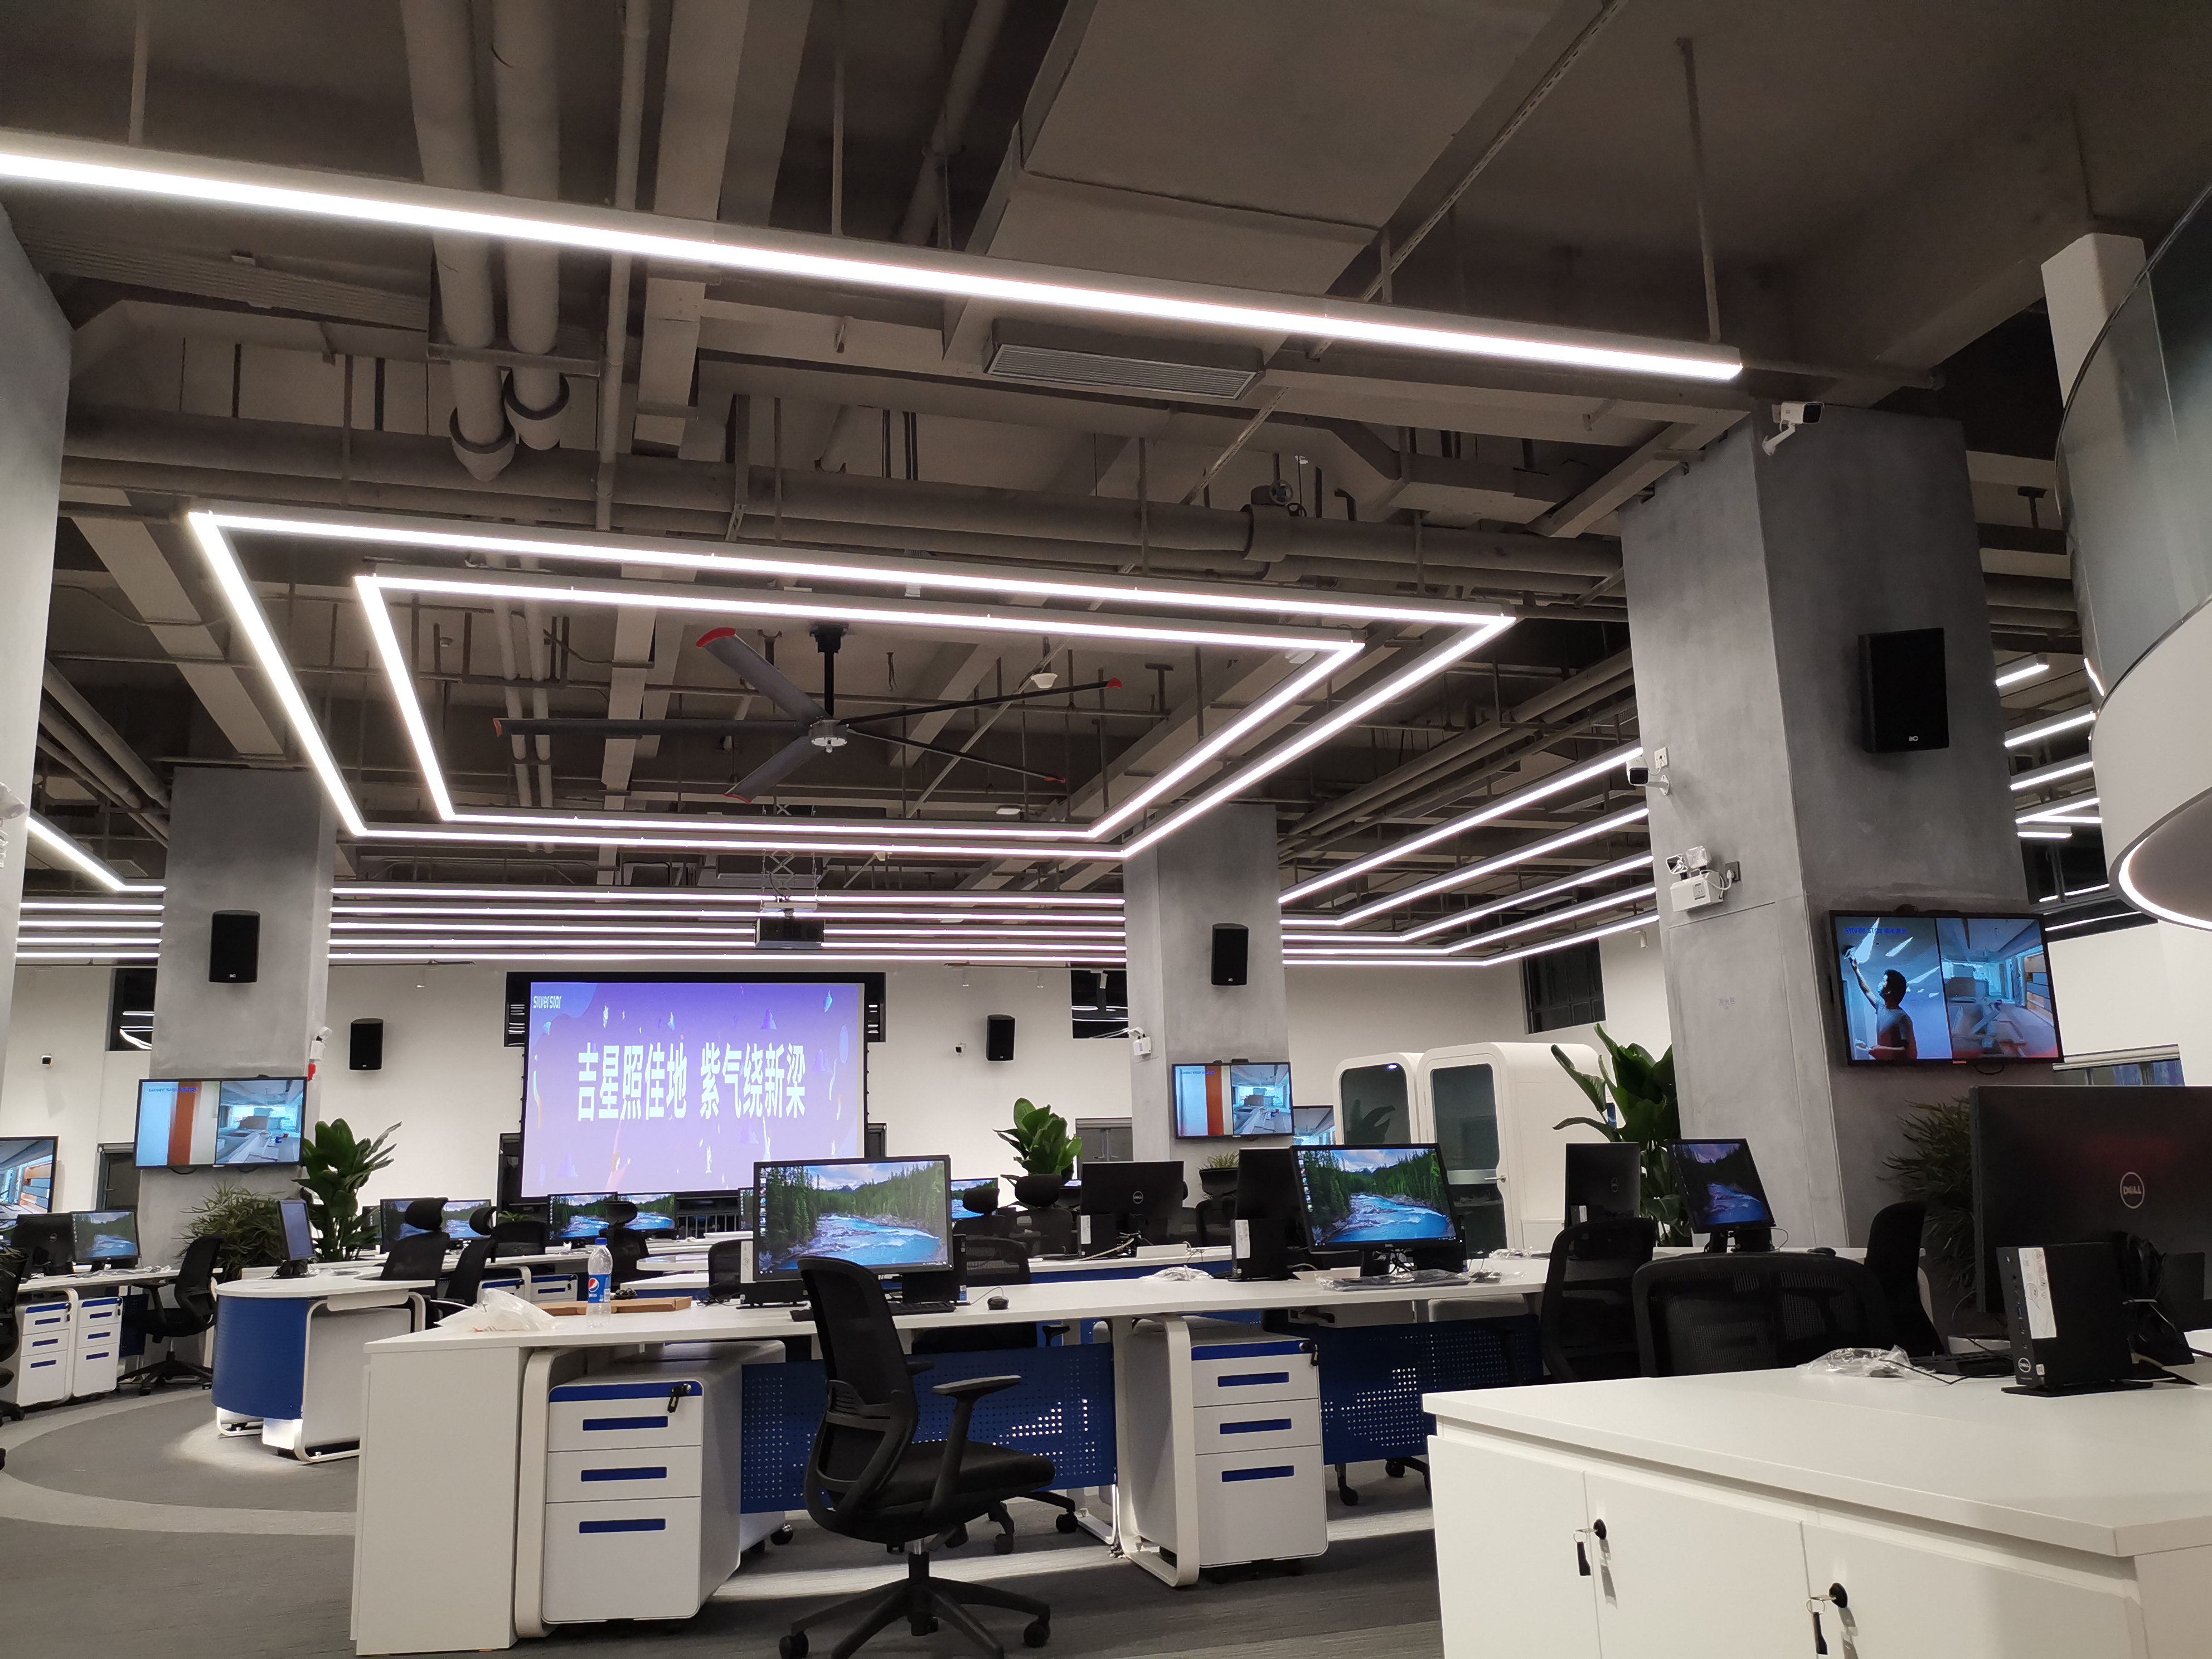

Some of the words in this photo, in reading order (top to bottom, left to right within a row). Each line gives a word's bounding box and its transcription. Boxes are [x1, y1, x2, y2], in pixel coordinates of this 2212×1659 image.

[578, 1042, 687, 1122] 吉星照佳地
[700, 1042, 806, 1119] 紫气绕新梁
